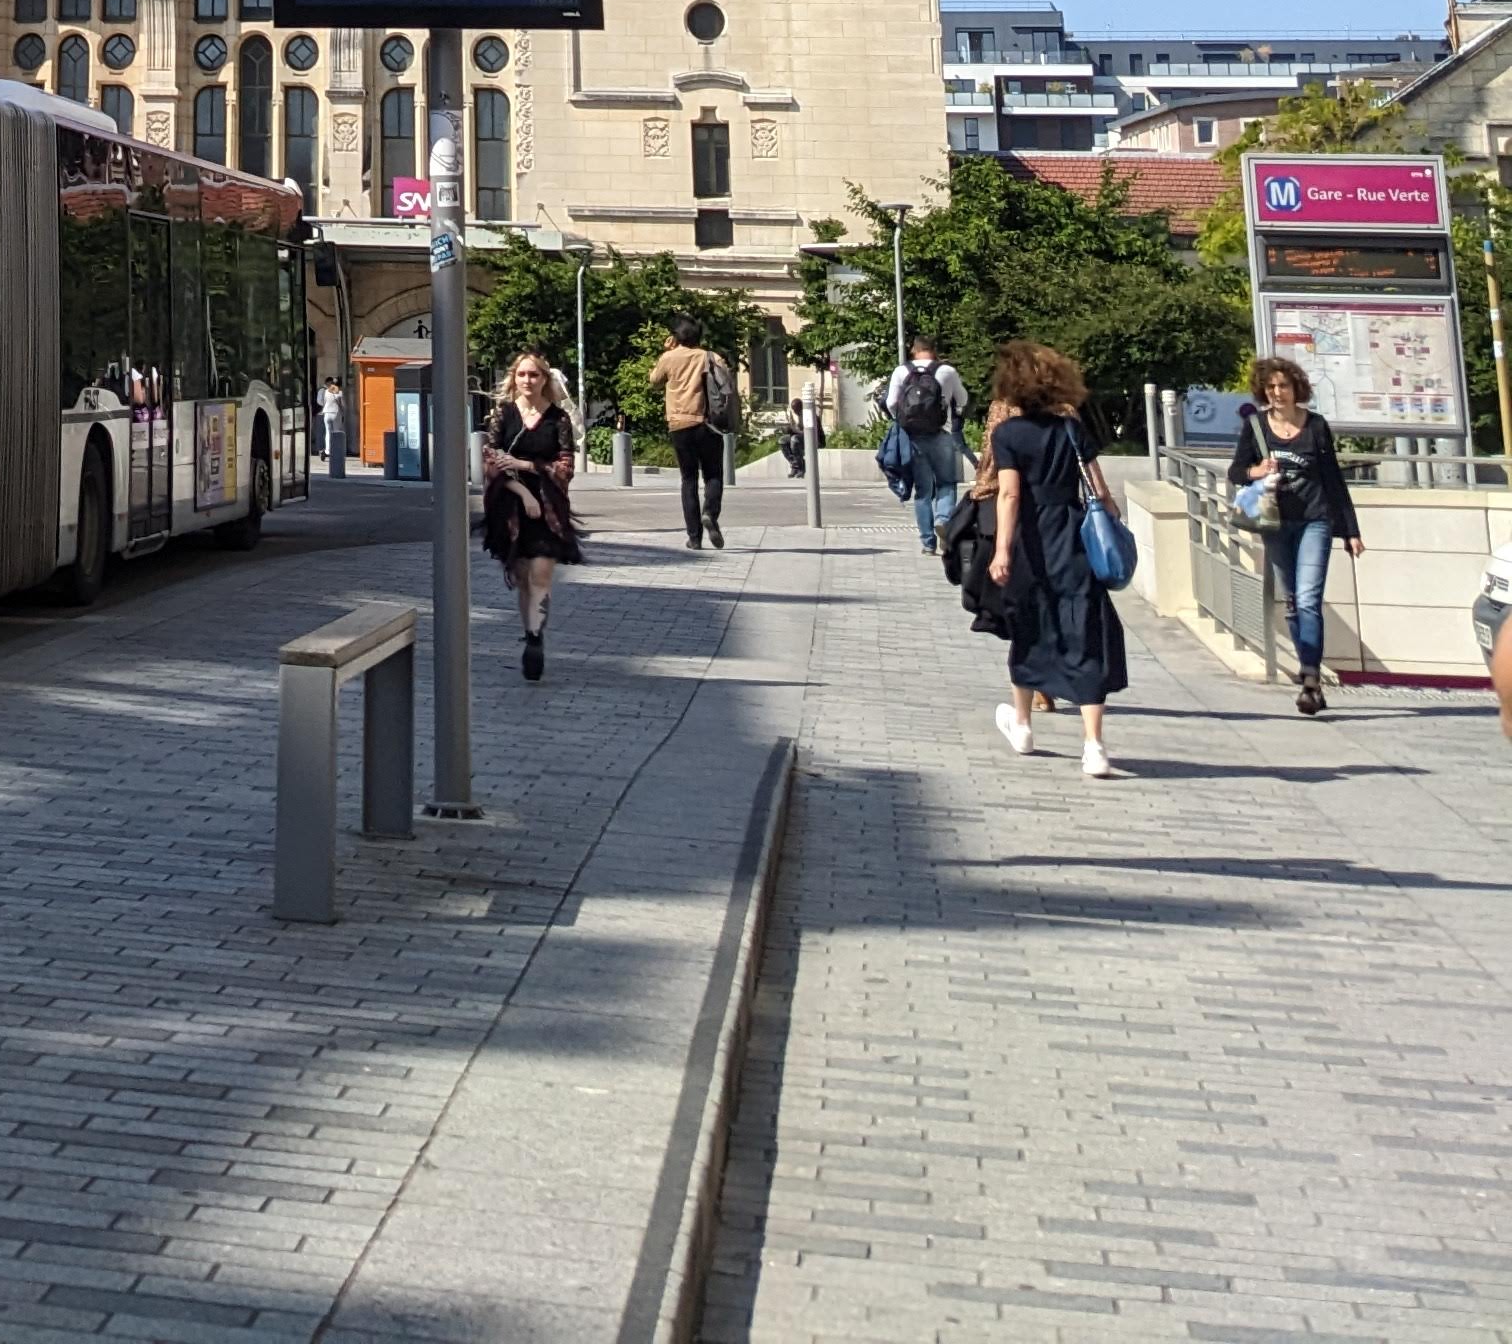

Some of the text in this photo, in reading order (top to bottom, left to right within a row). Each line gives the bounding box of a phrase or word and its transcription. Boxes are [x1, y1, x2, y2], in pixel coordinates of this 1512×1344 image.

[1270, 181, 1296, 206] M
[1307, 187, 1342, 201] Gare
[1357, 187, 1385, 201] Rue
[1388, 188, 1430, 202] Verte
